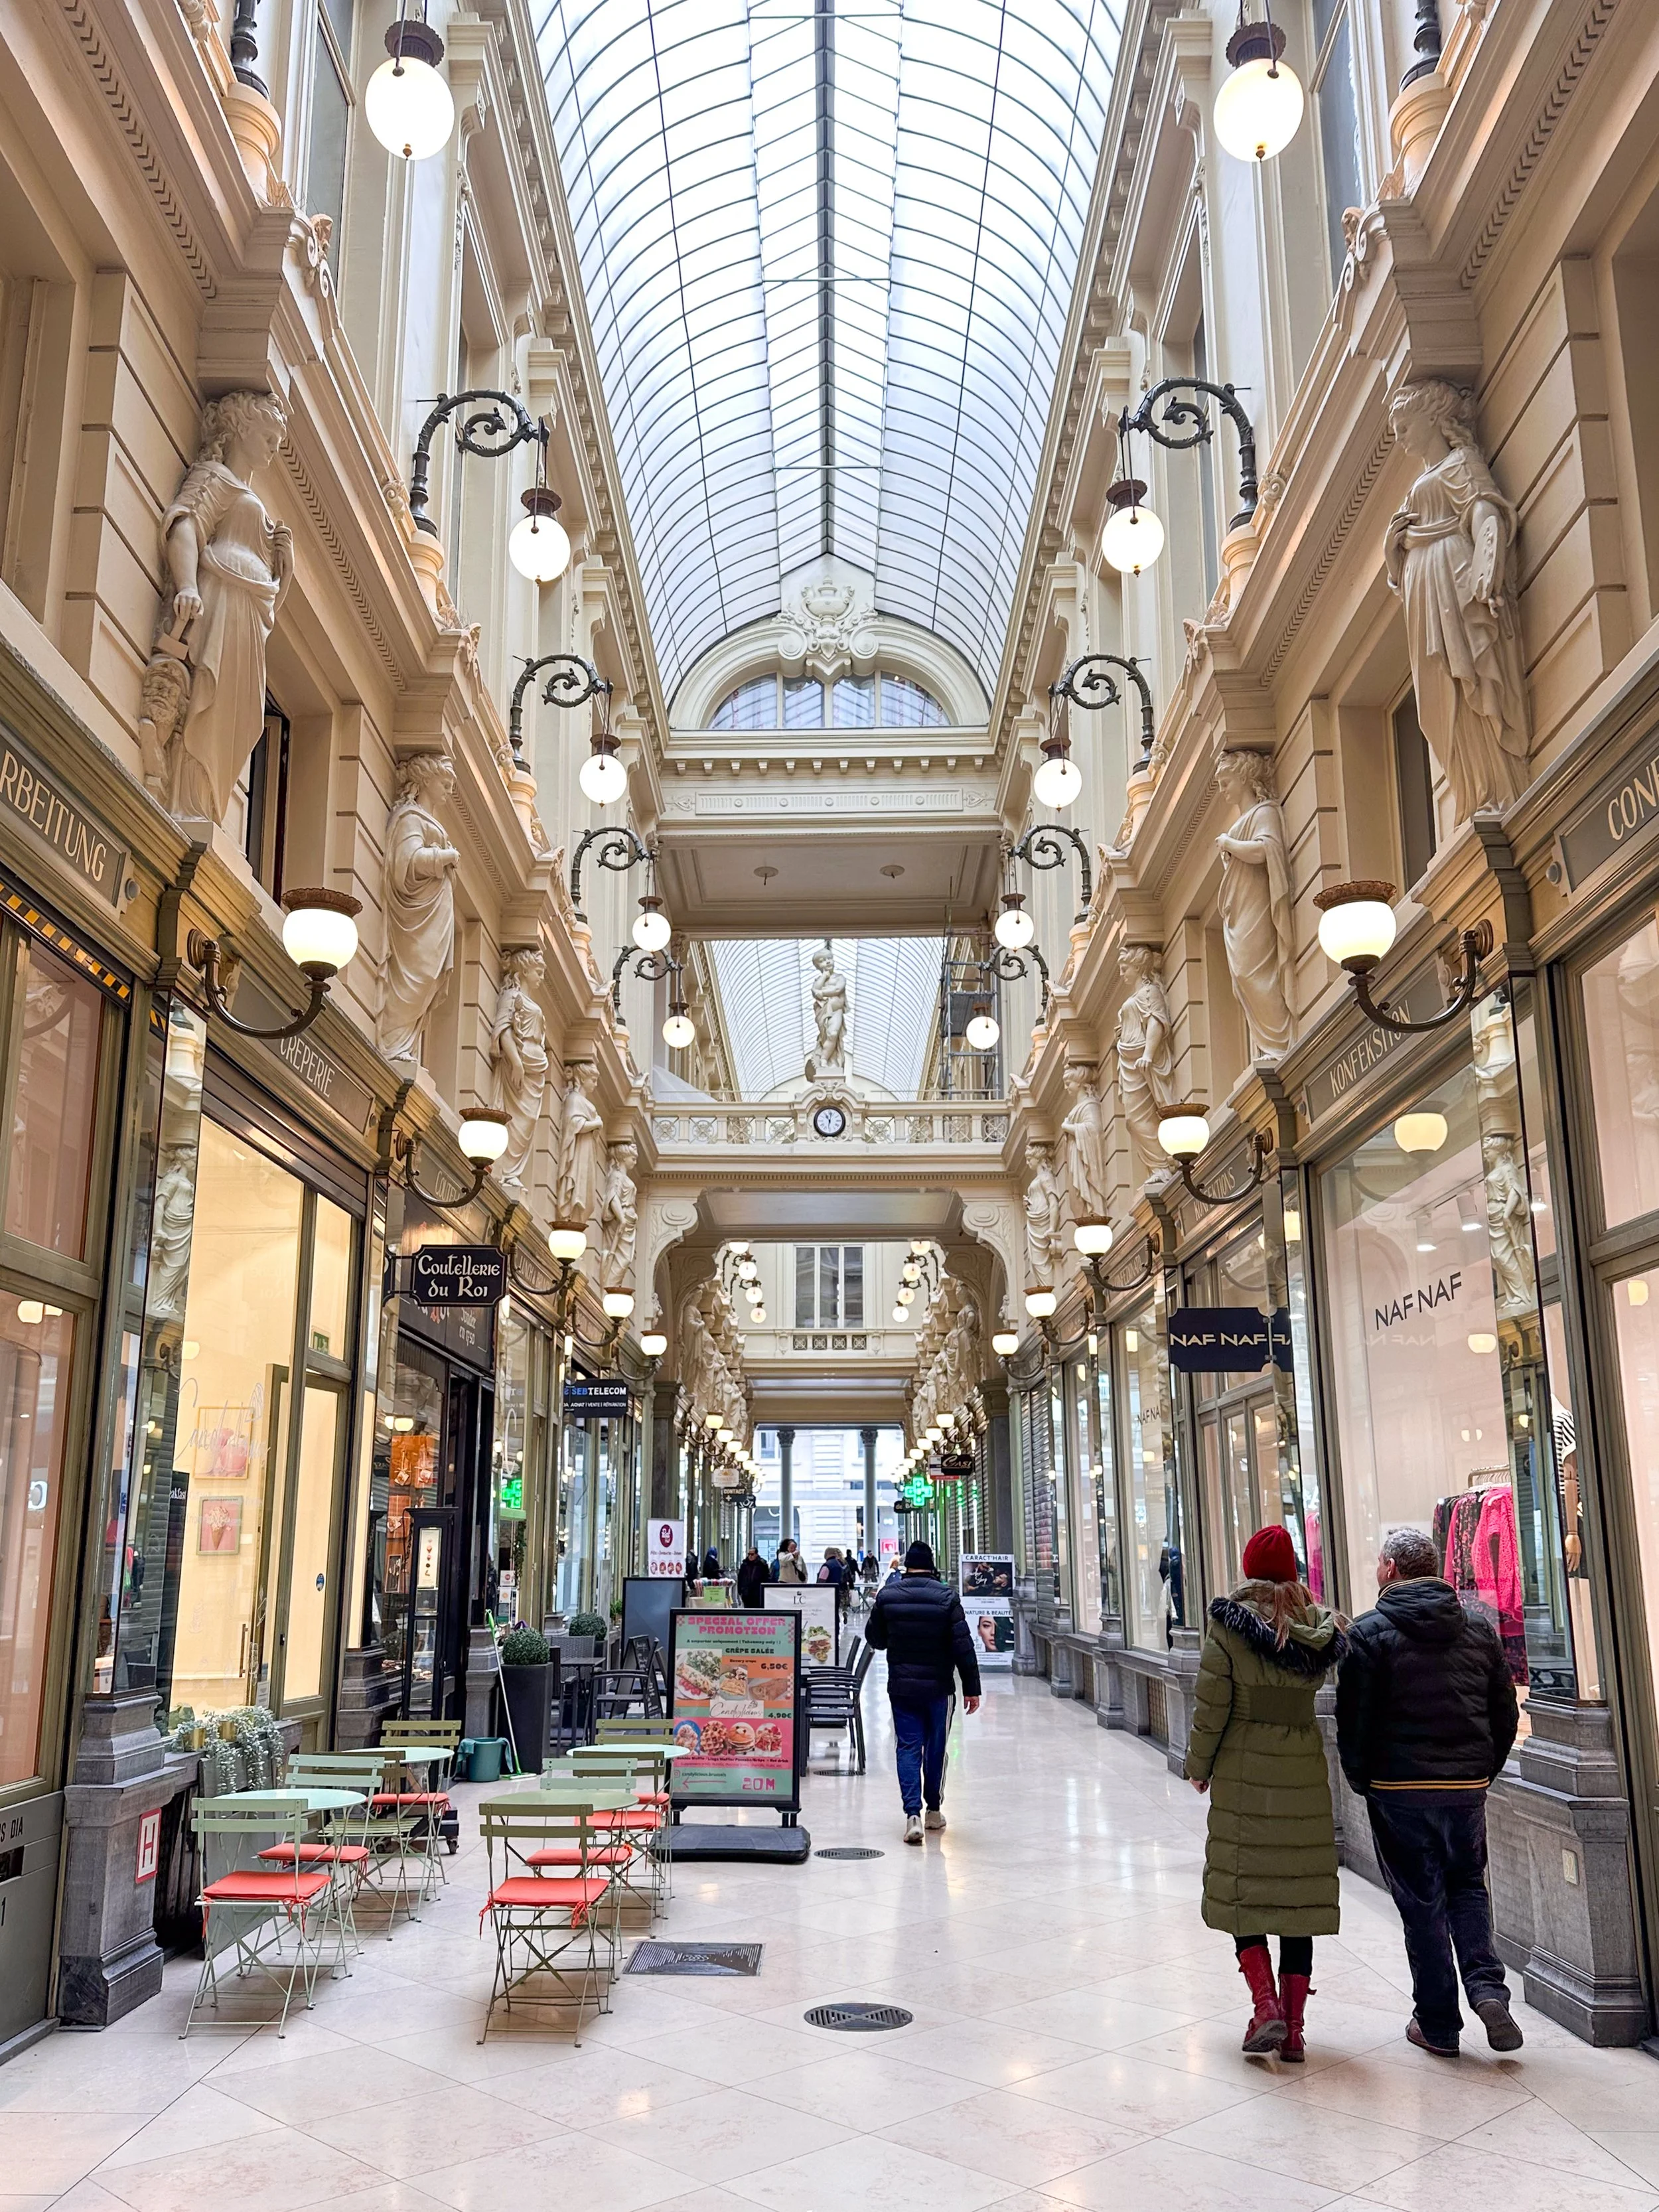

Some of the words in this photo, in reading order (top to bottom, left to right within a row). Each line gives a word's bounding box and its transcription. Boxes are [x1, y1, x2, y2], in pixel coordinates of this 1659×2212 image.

[427, 1278, 449, 1297] du
[457, 1276, 488, 1297] Roi
[1375, 1293, 1413, 1331] NAF
[1417, 1271, 1463, 1313] NAF
[1170, 1333, 1216, 1347] NAF
[1220, 1332, 1267, 1347] NAF
[571, 1386, 626, 1396] SEBTELECOM
[793, 1596, 807, 1605] LC
[687, 1616, 743, 1625] SPECIAL
[747, 1616, 786, 1626] OFFER
[10, 1816, 23, 1840] DIA
[142, 1822, 156, 1868] H
